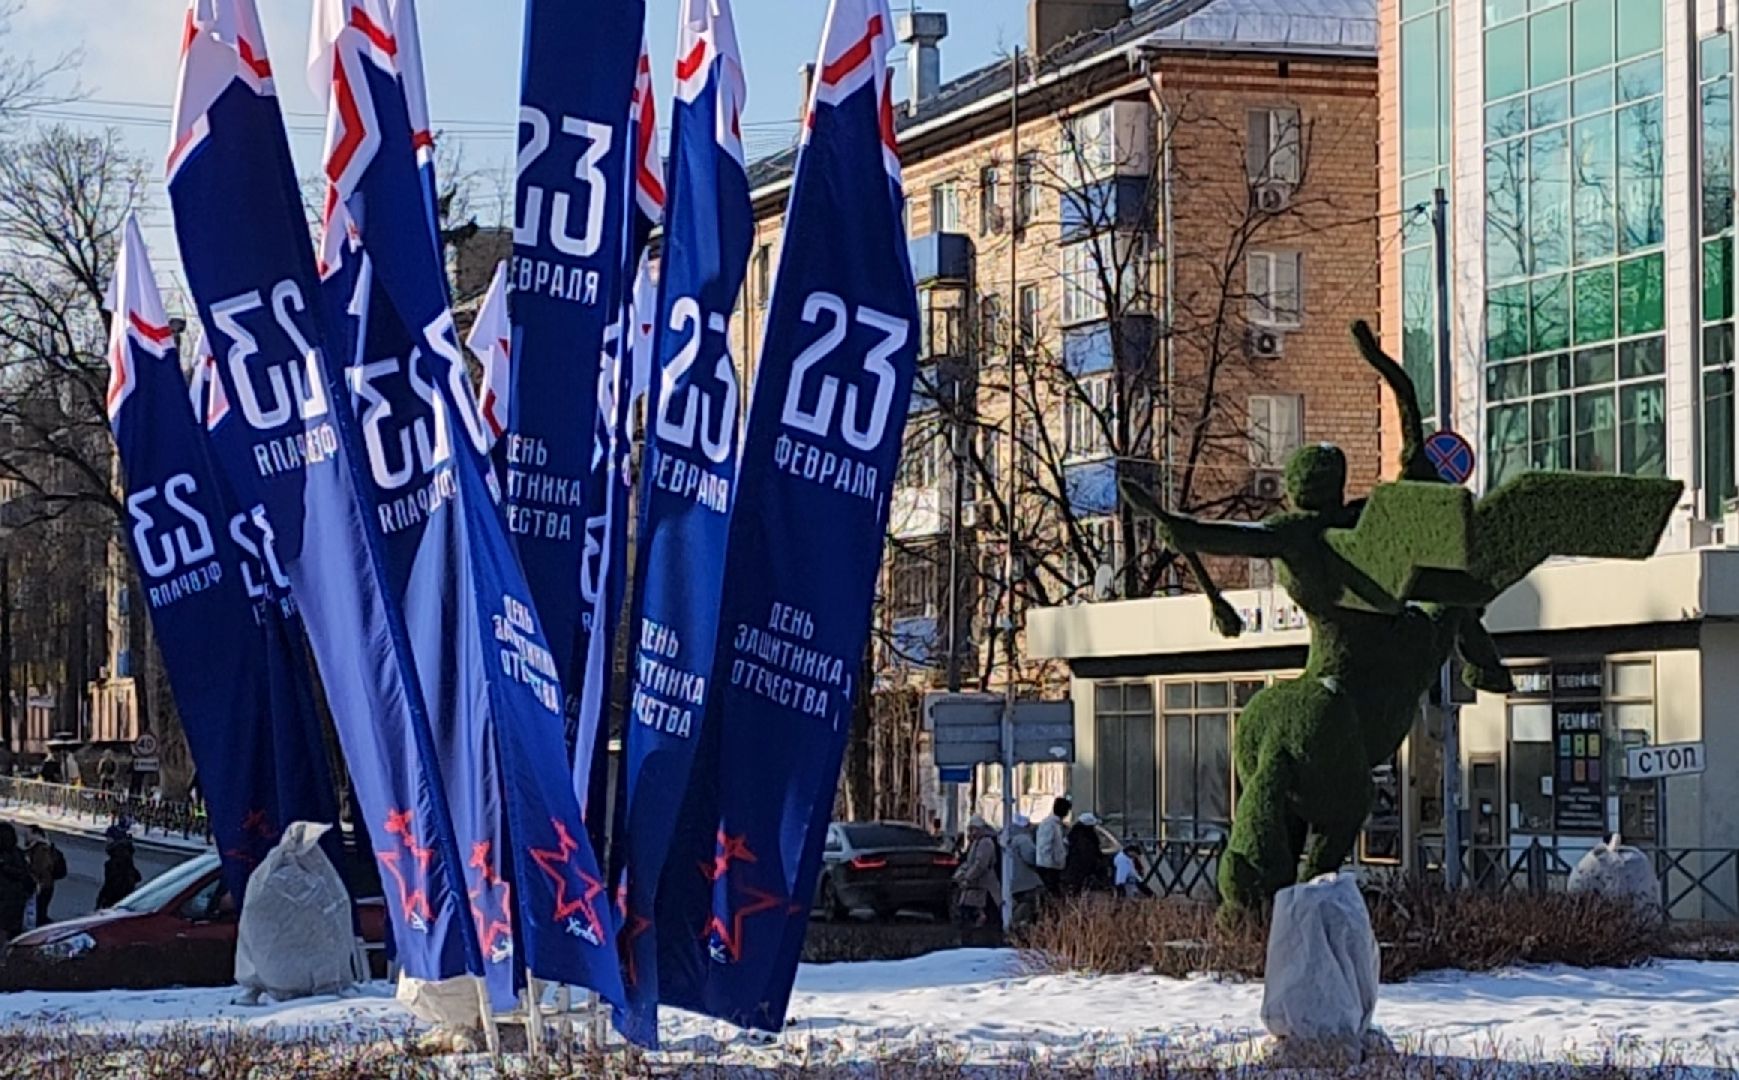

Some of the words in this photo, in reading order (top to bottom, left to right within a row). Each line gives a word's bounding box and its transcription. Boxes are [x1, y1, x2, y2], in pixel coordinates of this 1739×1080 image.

[513, 105, 613, 257] 23
[506, 255, 601, 305] ЕВРАЛЯ
[656, 297, 738, 463] 23
[783, 291, 909, 451] 23
[774, 432, 878, 500] ФЕВРАЛЯ
[767, 601, 815, 641] ДЕНЬ
[734, 623, 844, 687] ЗАЩИТНИКА
[731, 659, 829, 719] ОТЕЧЕСТВА
[1638, 746, 1697, 773] СТОП
